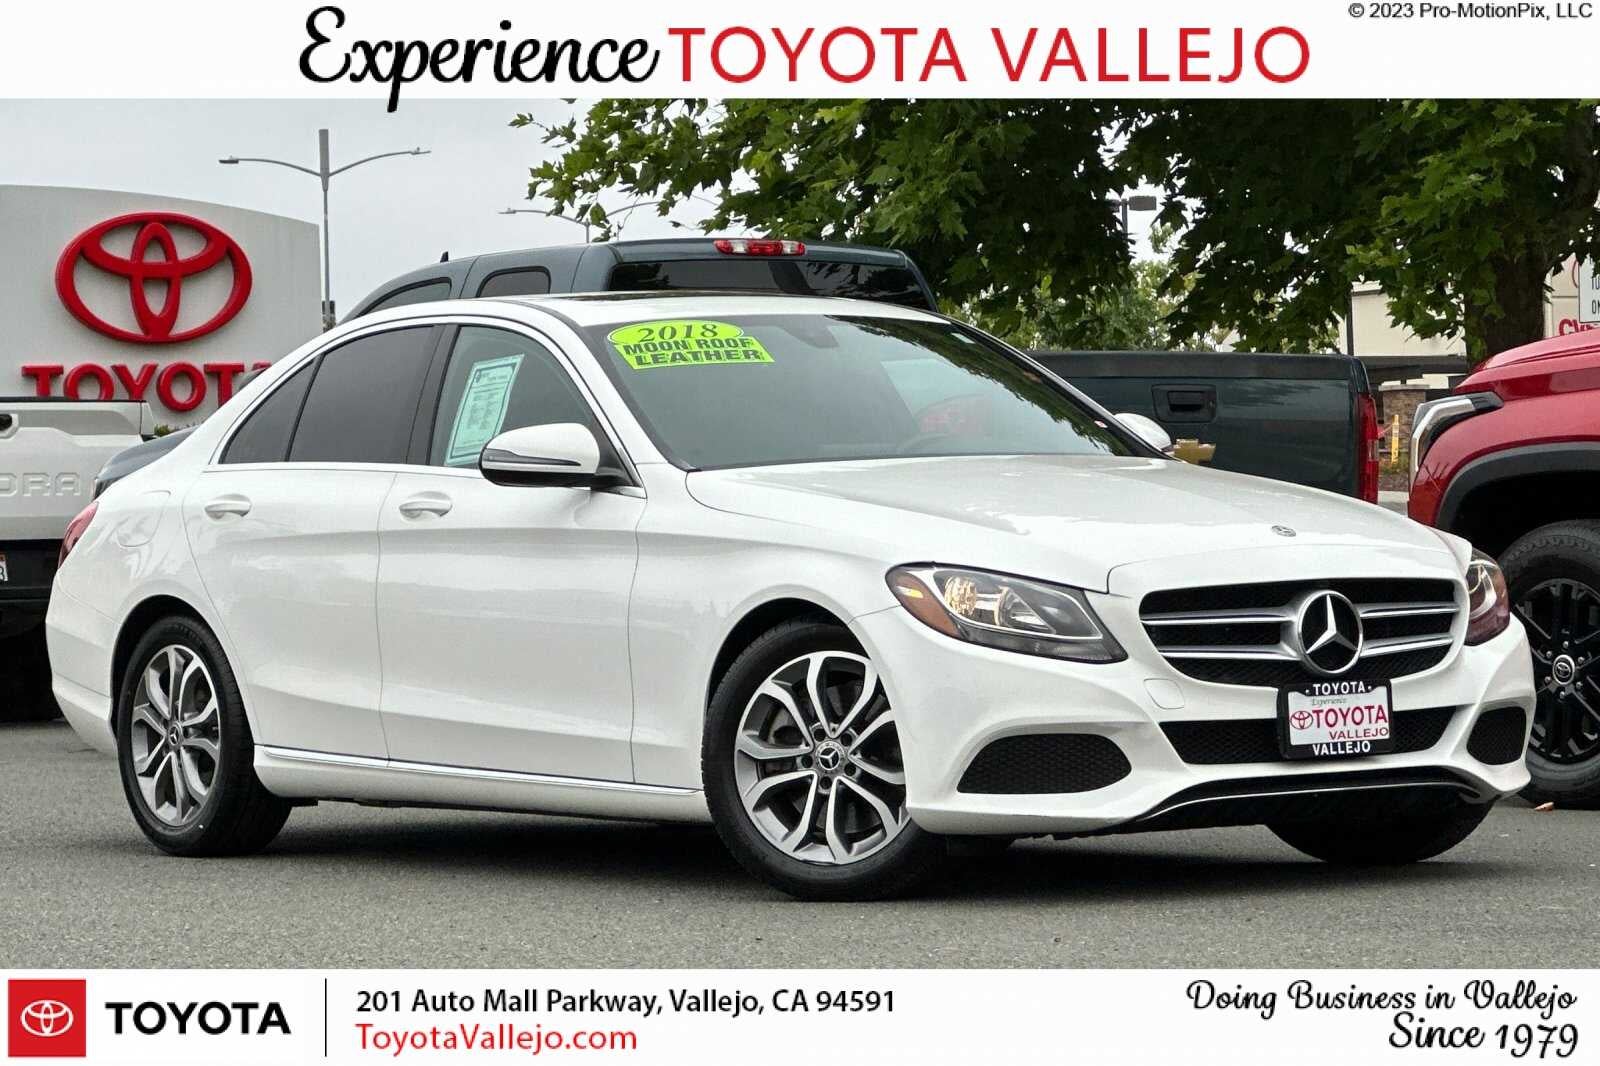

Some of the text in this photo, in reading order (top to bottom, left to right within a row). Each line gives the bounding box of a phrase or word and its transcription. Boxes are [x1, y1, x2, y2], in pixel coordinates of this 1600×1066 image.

[637, 322, 718, 343] 2018
[1559, 318, 1593, 337] CV
[623, 337, 754, 355] MOON ROOF
[634, 348, 764, 366] LEATHER
[21, 361, 273, 412] TOYOT
[1313, 681, 1365, 695] TOYOTA
[1312, 705, 1387, 728] TOYOTA
[1329, 727, 1388, 740] VALLEJO
[1313, 741, 1371, 755] VALLEJO
